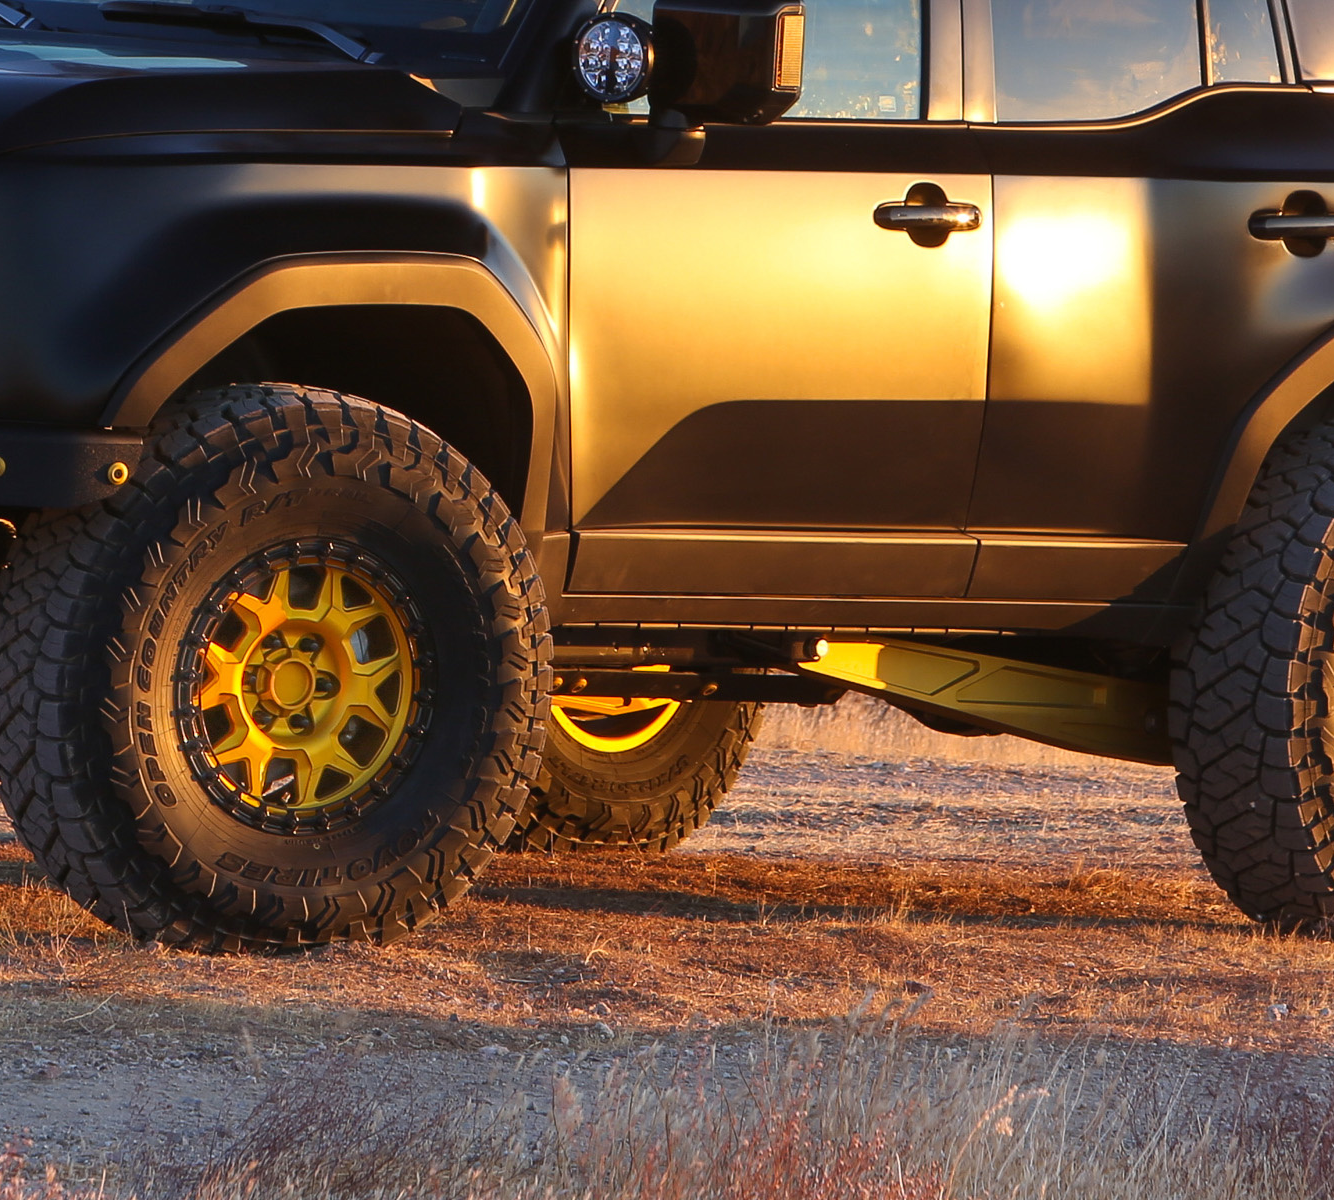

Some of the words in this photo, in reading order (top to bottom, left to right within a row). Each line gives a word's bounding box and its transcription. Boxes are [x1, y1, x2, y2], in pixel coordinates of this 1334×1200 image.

[136, 519, 230, 693] COUNTRY
[136, 700, 178, 807] OPEN
[215, 851, 344, 888] TIRES
